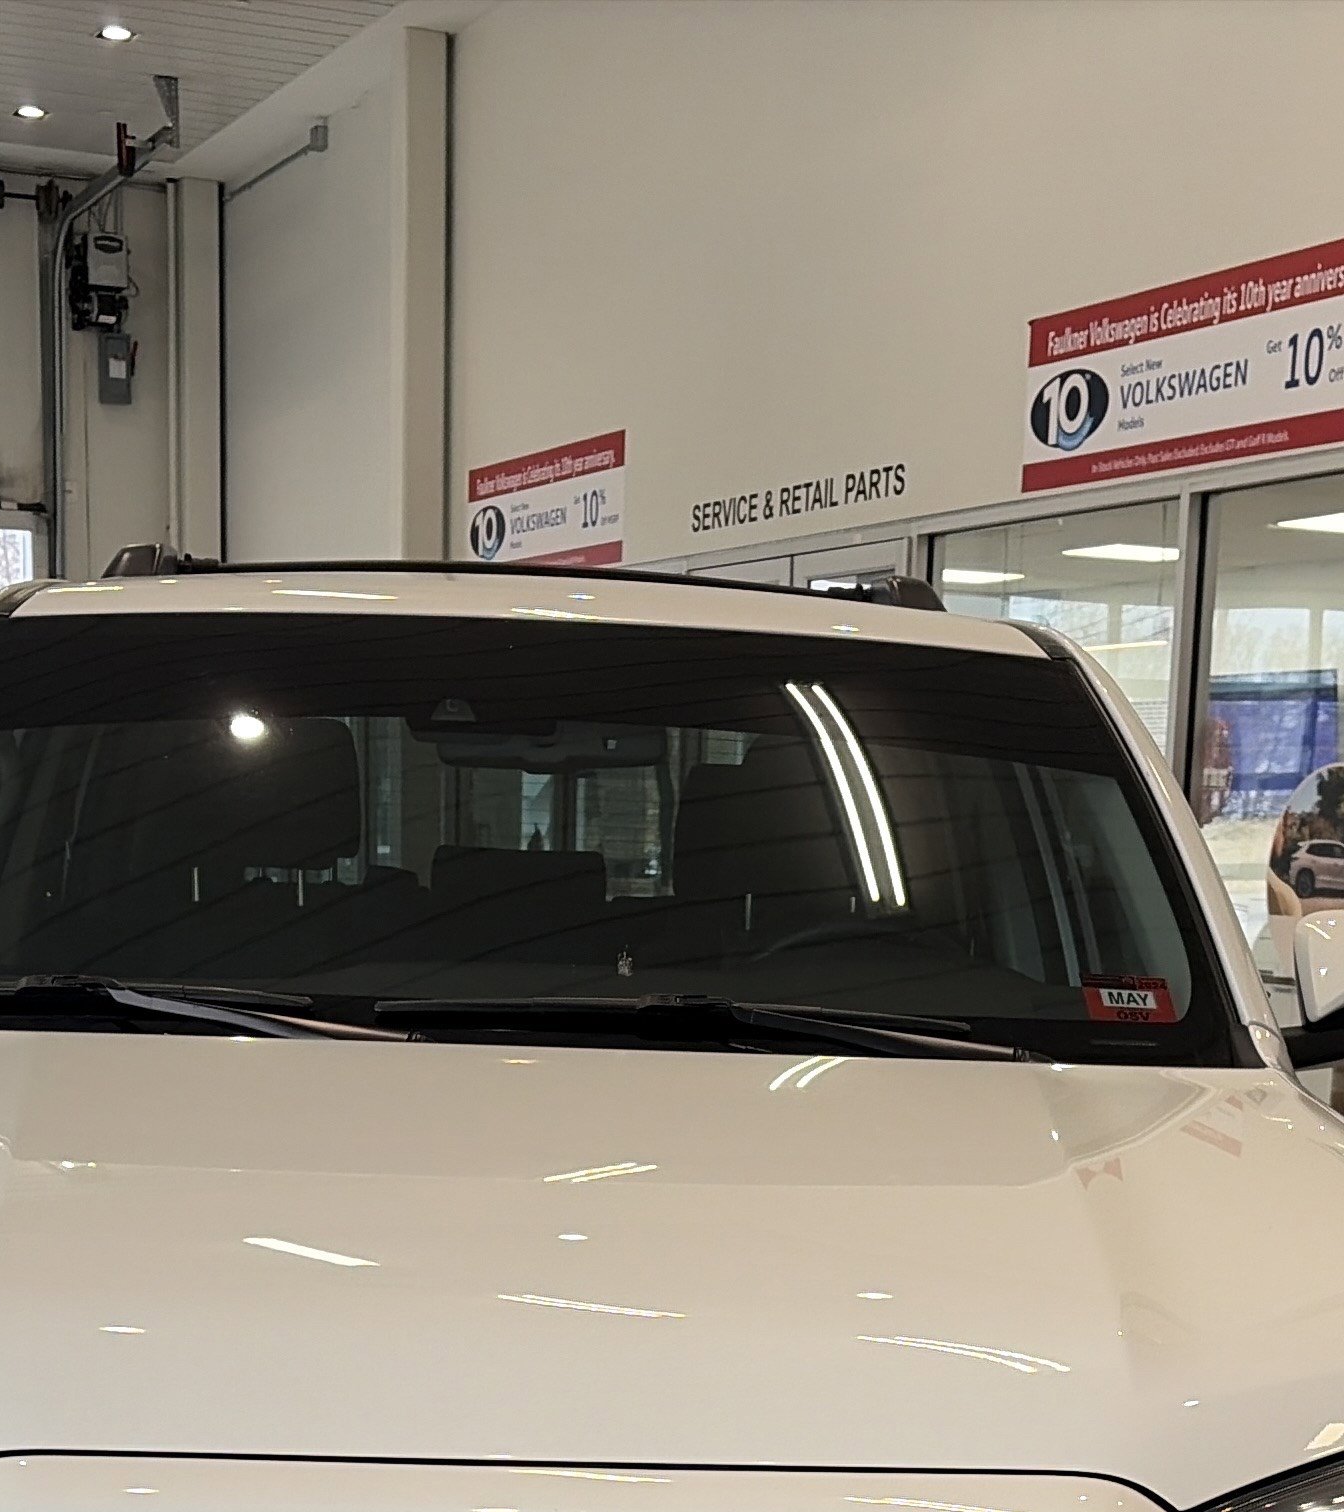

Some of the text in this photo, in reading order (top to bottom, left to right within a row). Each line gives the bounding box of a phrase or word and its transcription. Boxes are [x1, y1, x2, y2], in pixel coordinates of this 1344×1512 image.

[1160, 291, 1221, 330] Celebrating
[1239, 277, 1266, 311] 10th
[1265, 279, 1294, 312] year
[1266, 340, 1282, 354] Get
[1120, 358, 1249, 409] VOLKSWAGEN
[691, 463, 906, 532] SERVICE & RETAIL PARTS
[510, 506, 567, 535] VOLKSWAGEN
[1107, 992, 1149, 1006] MAY
